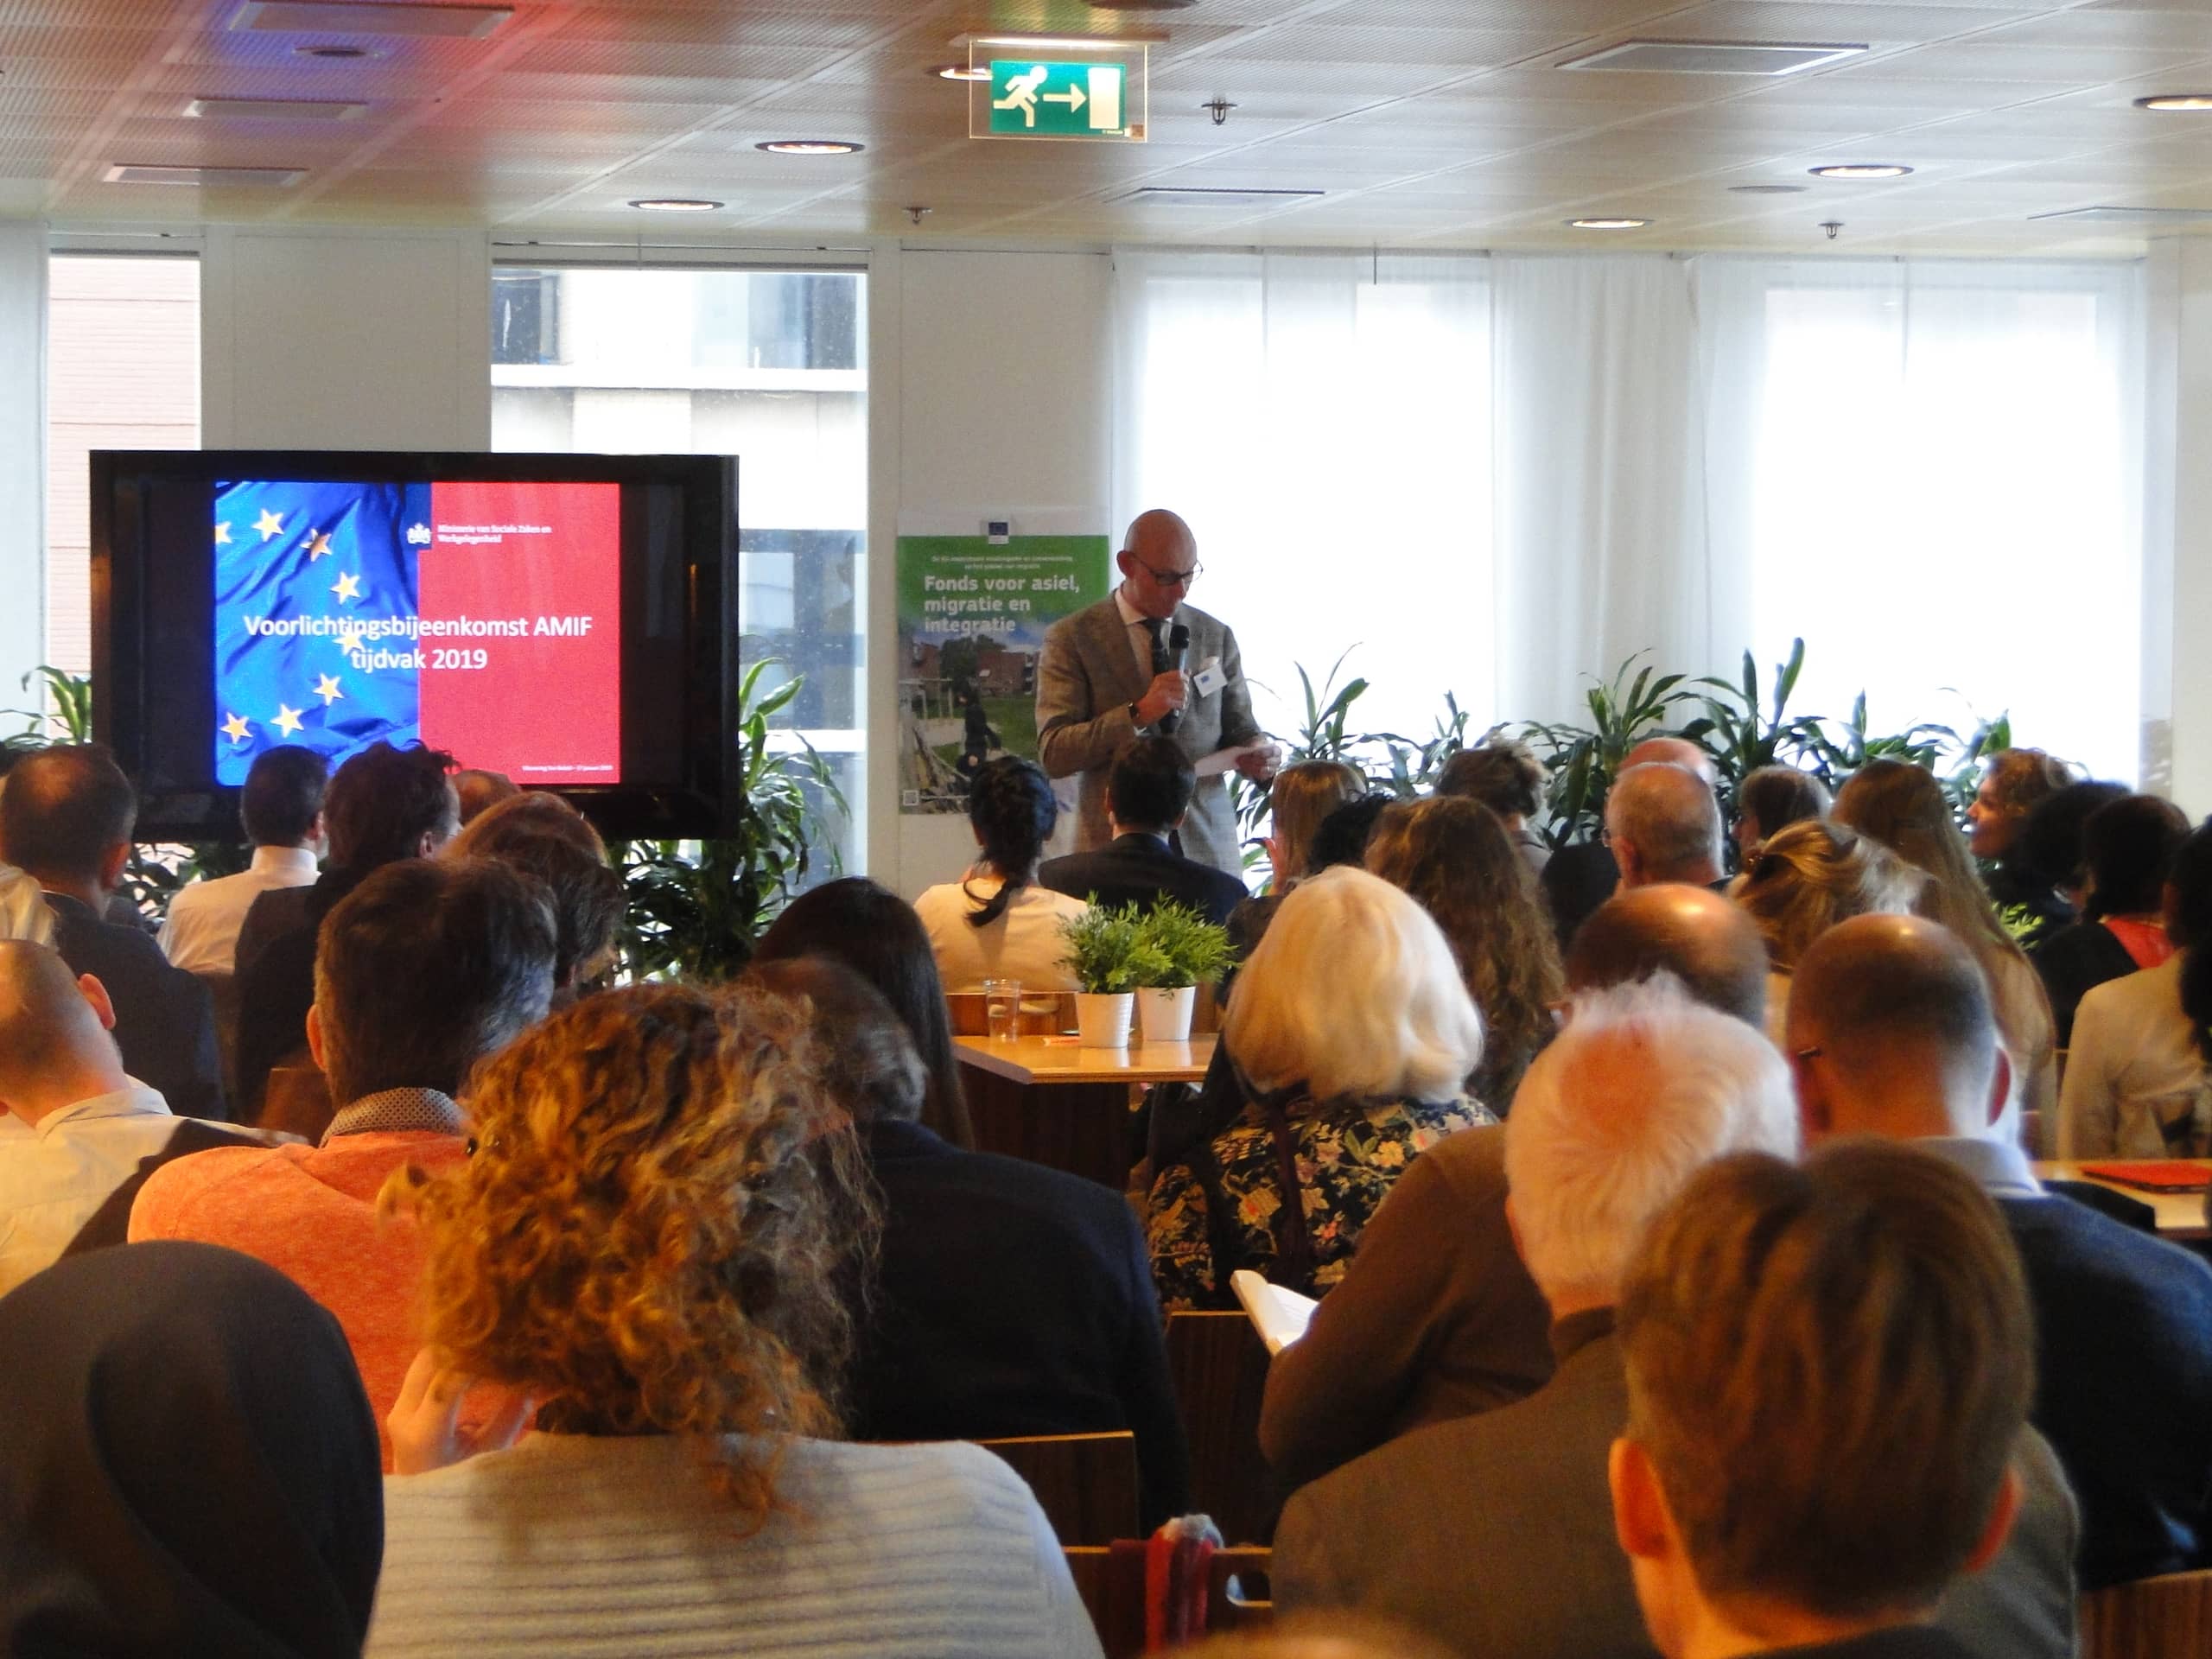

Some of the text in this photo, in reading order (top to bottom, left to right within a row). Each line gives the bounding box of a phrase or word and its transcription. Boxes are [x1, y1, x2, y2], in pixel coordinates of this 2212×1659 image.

[924, 574, 1081, 594] Fonds voor asiel,
[924, 596, 1031, 616] migratie en
[243, 615, 593, 641] Voorlichtingsbijeenkomst AMIF
[925, 616, 1016, 637] integratie
[351, 647, 488, 673] tijdvak 2019
